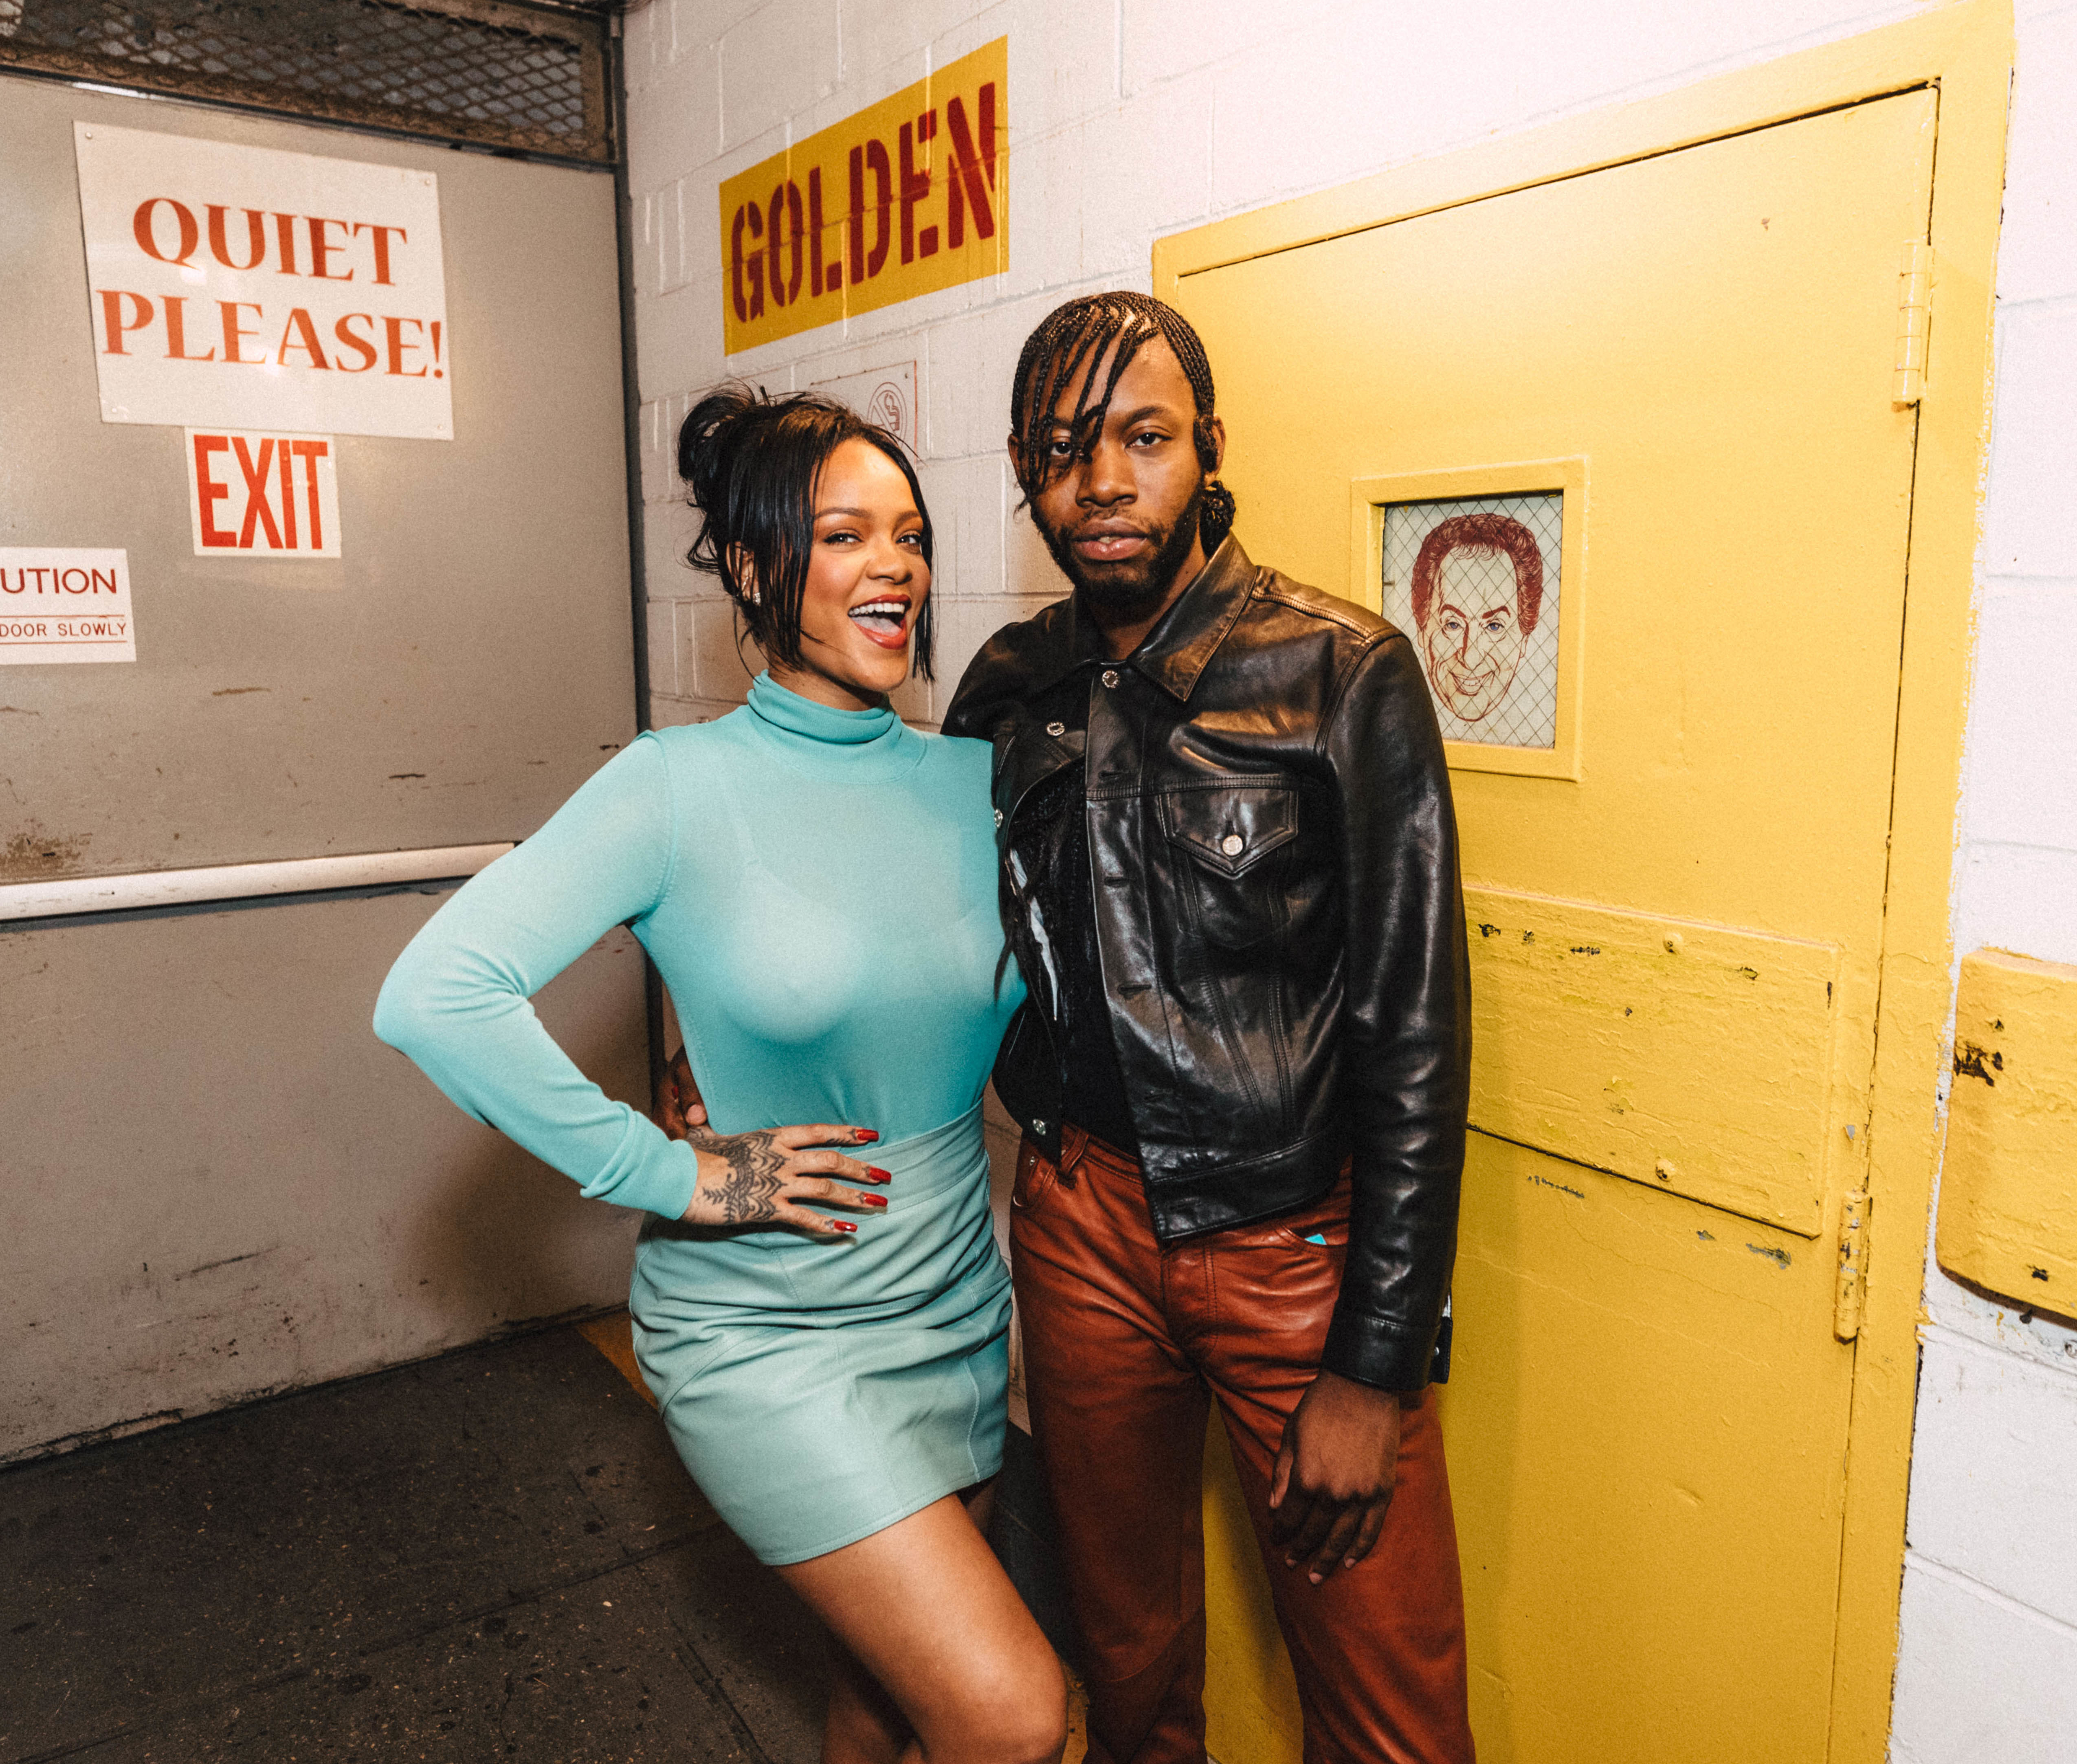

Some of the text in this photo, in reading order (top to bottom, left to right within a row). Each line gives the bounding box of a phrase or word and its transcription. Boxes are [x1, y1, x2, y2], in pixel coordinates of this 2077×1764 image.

[133, 197, 407, 286] QUIET
[731, 82, 996, 323] GOLDEN
[96, 290, 444, 378] PLEASE!
[193, 434, 328, 549] EXIT
[0, 568, 117, 594] UTION
[0, 623, 126, 637] DOOR SLOWLY
